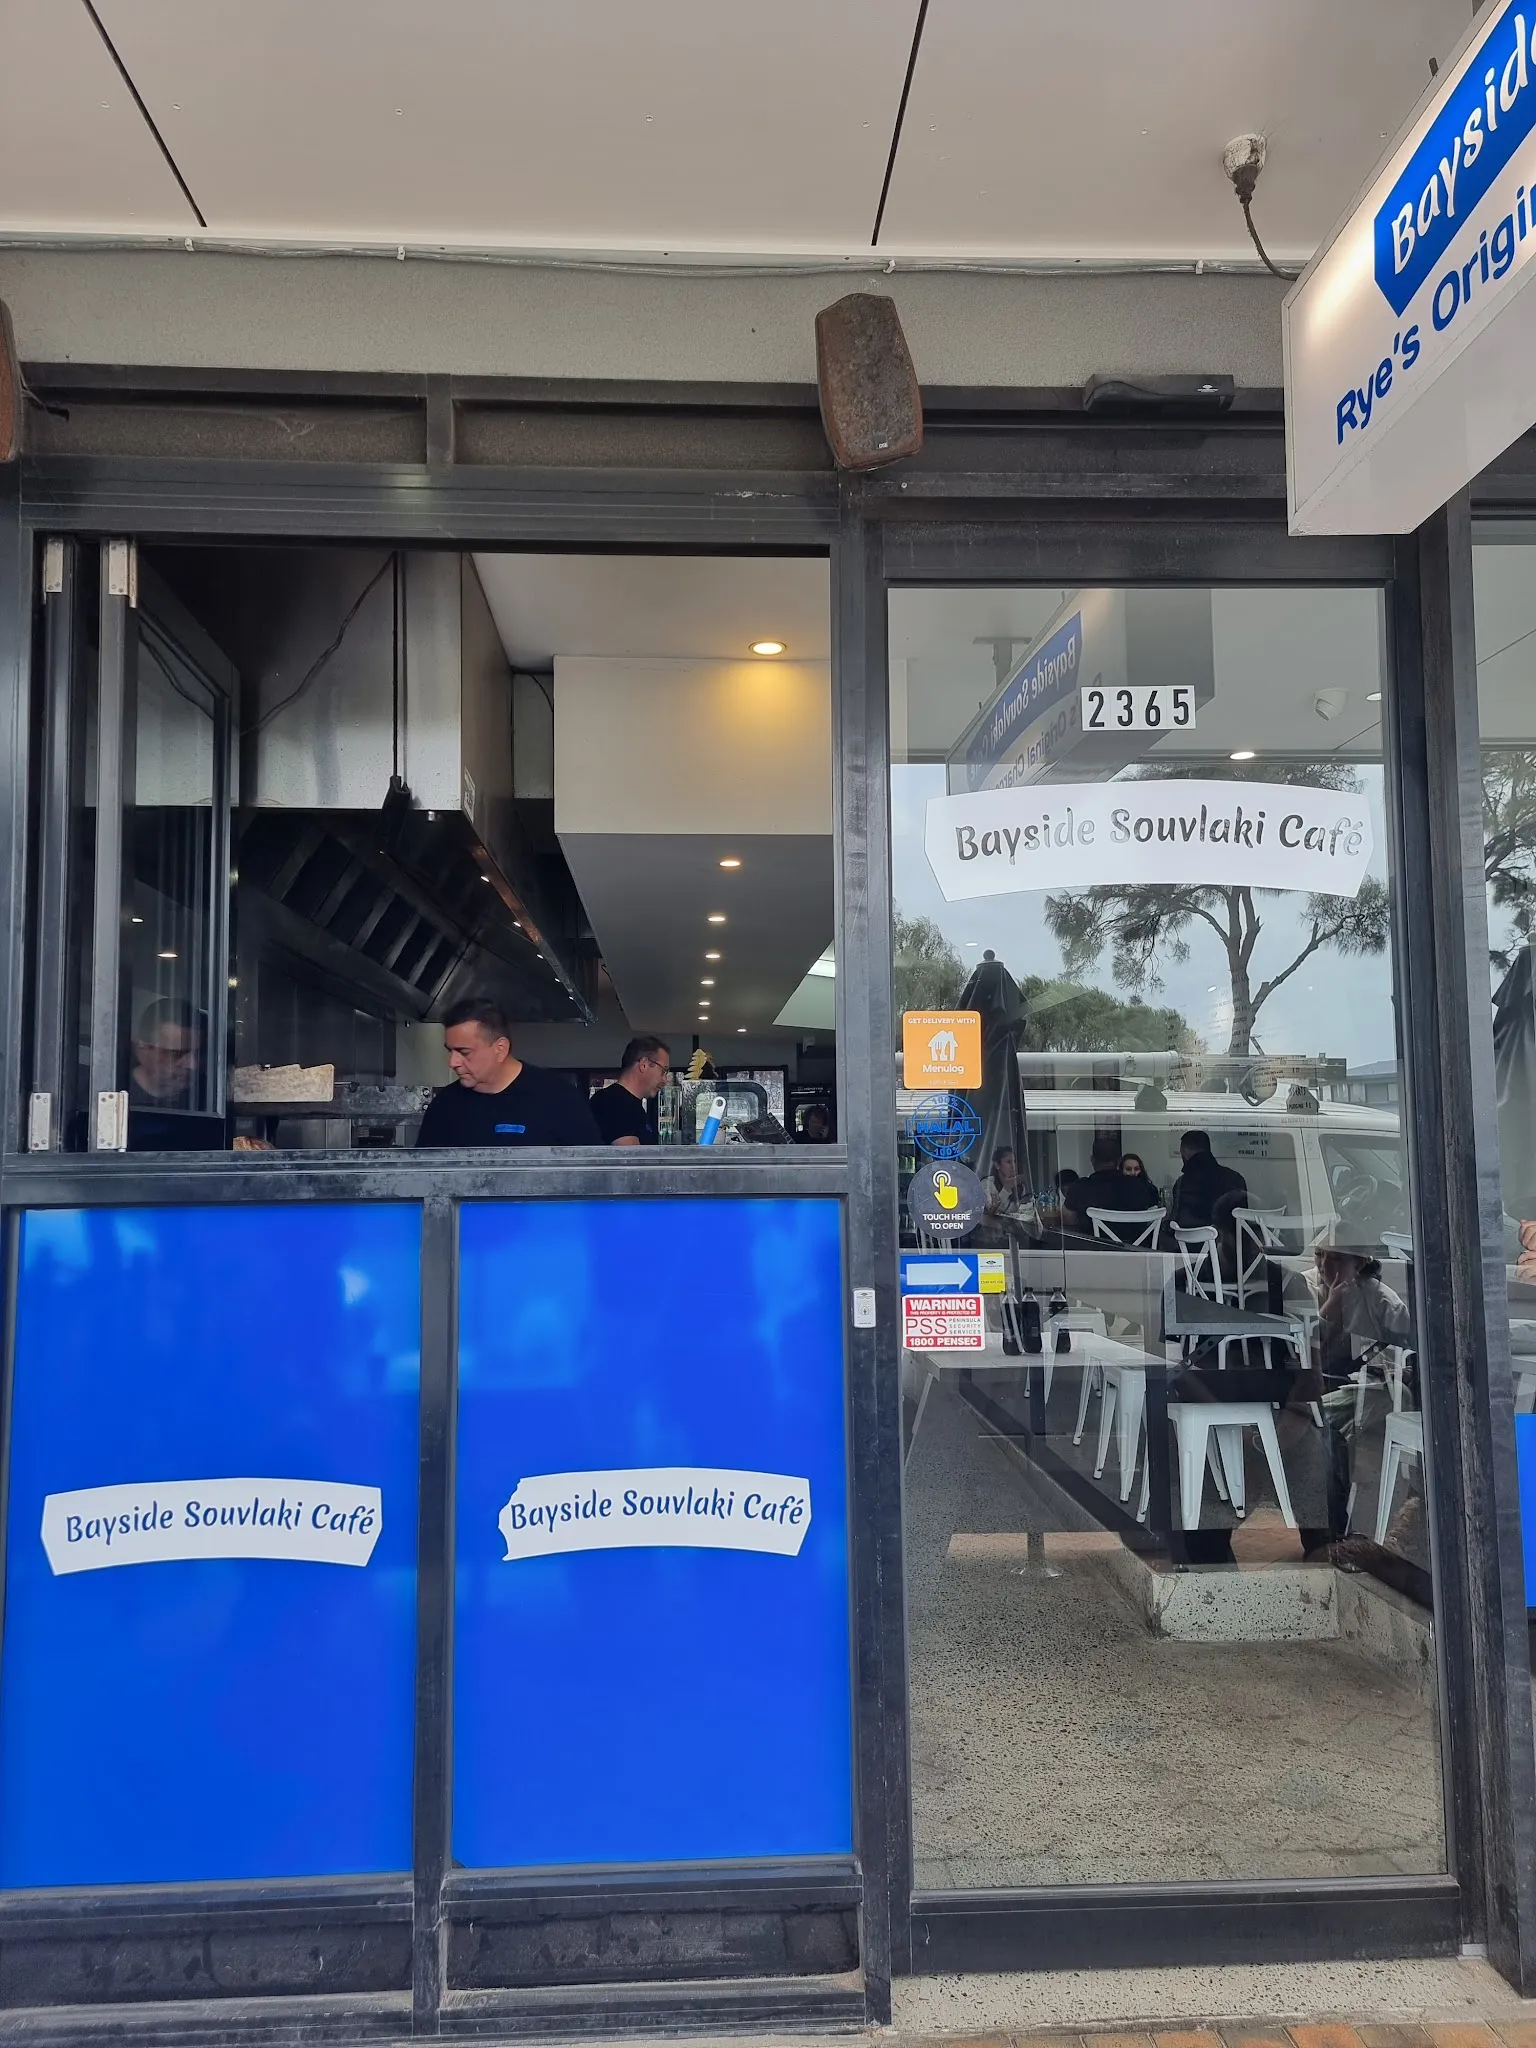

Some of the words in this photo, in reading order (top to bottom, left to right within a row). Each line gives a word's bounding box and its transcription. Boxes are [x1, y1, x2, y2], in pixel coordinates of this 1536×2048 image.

[1391, 14, 1536, 275] Baysid
[1336, 323, 1421, 445] Rye's
[1087, 687, 1191, 729] 2365
[955, 806, 1096, 866] Bayside
[1109, 804, 1266, 849] Souvlaki
[1279, 814, 1364, 858] Café
[922, 1063, 965, 1075] Menulog
[916, 1120, 975, 1134] HALAL
[934, 1146, 960, 1156] 100%
[922, 1213, 950, 1221] TOUCH
[951, 1213, 971, 1221] HERE
[930, 1222, 941, 1230] TO
[942, 1222, 964, 1230] OPEN
[909, 1298, 977, 1311] WARNING
[905, 1317, 948, 1335] PSS
[909, 1337, 934, 1346] 1800
[936, 1337, 978, 1346] PENSEC
[510, 1488, 613, 1534] Bayside
[622, 1486, 736, 1519] Souvlaki
[743, 1493, 805, 1526] Café
[66, 1500, 174, 1546] Bayside
[183, 1497, 303, 1531] Souvlaki
[311, 1503, 376, 1535] Café
